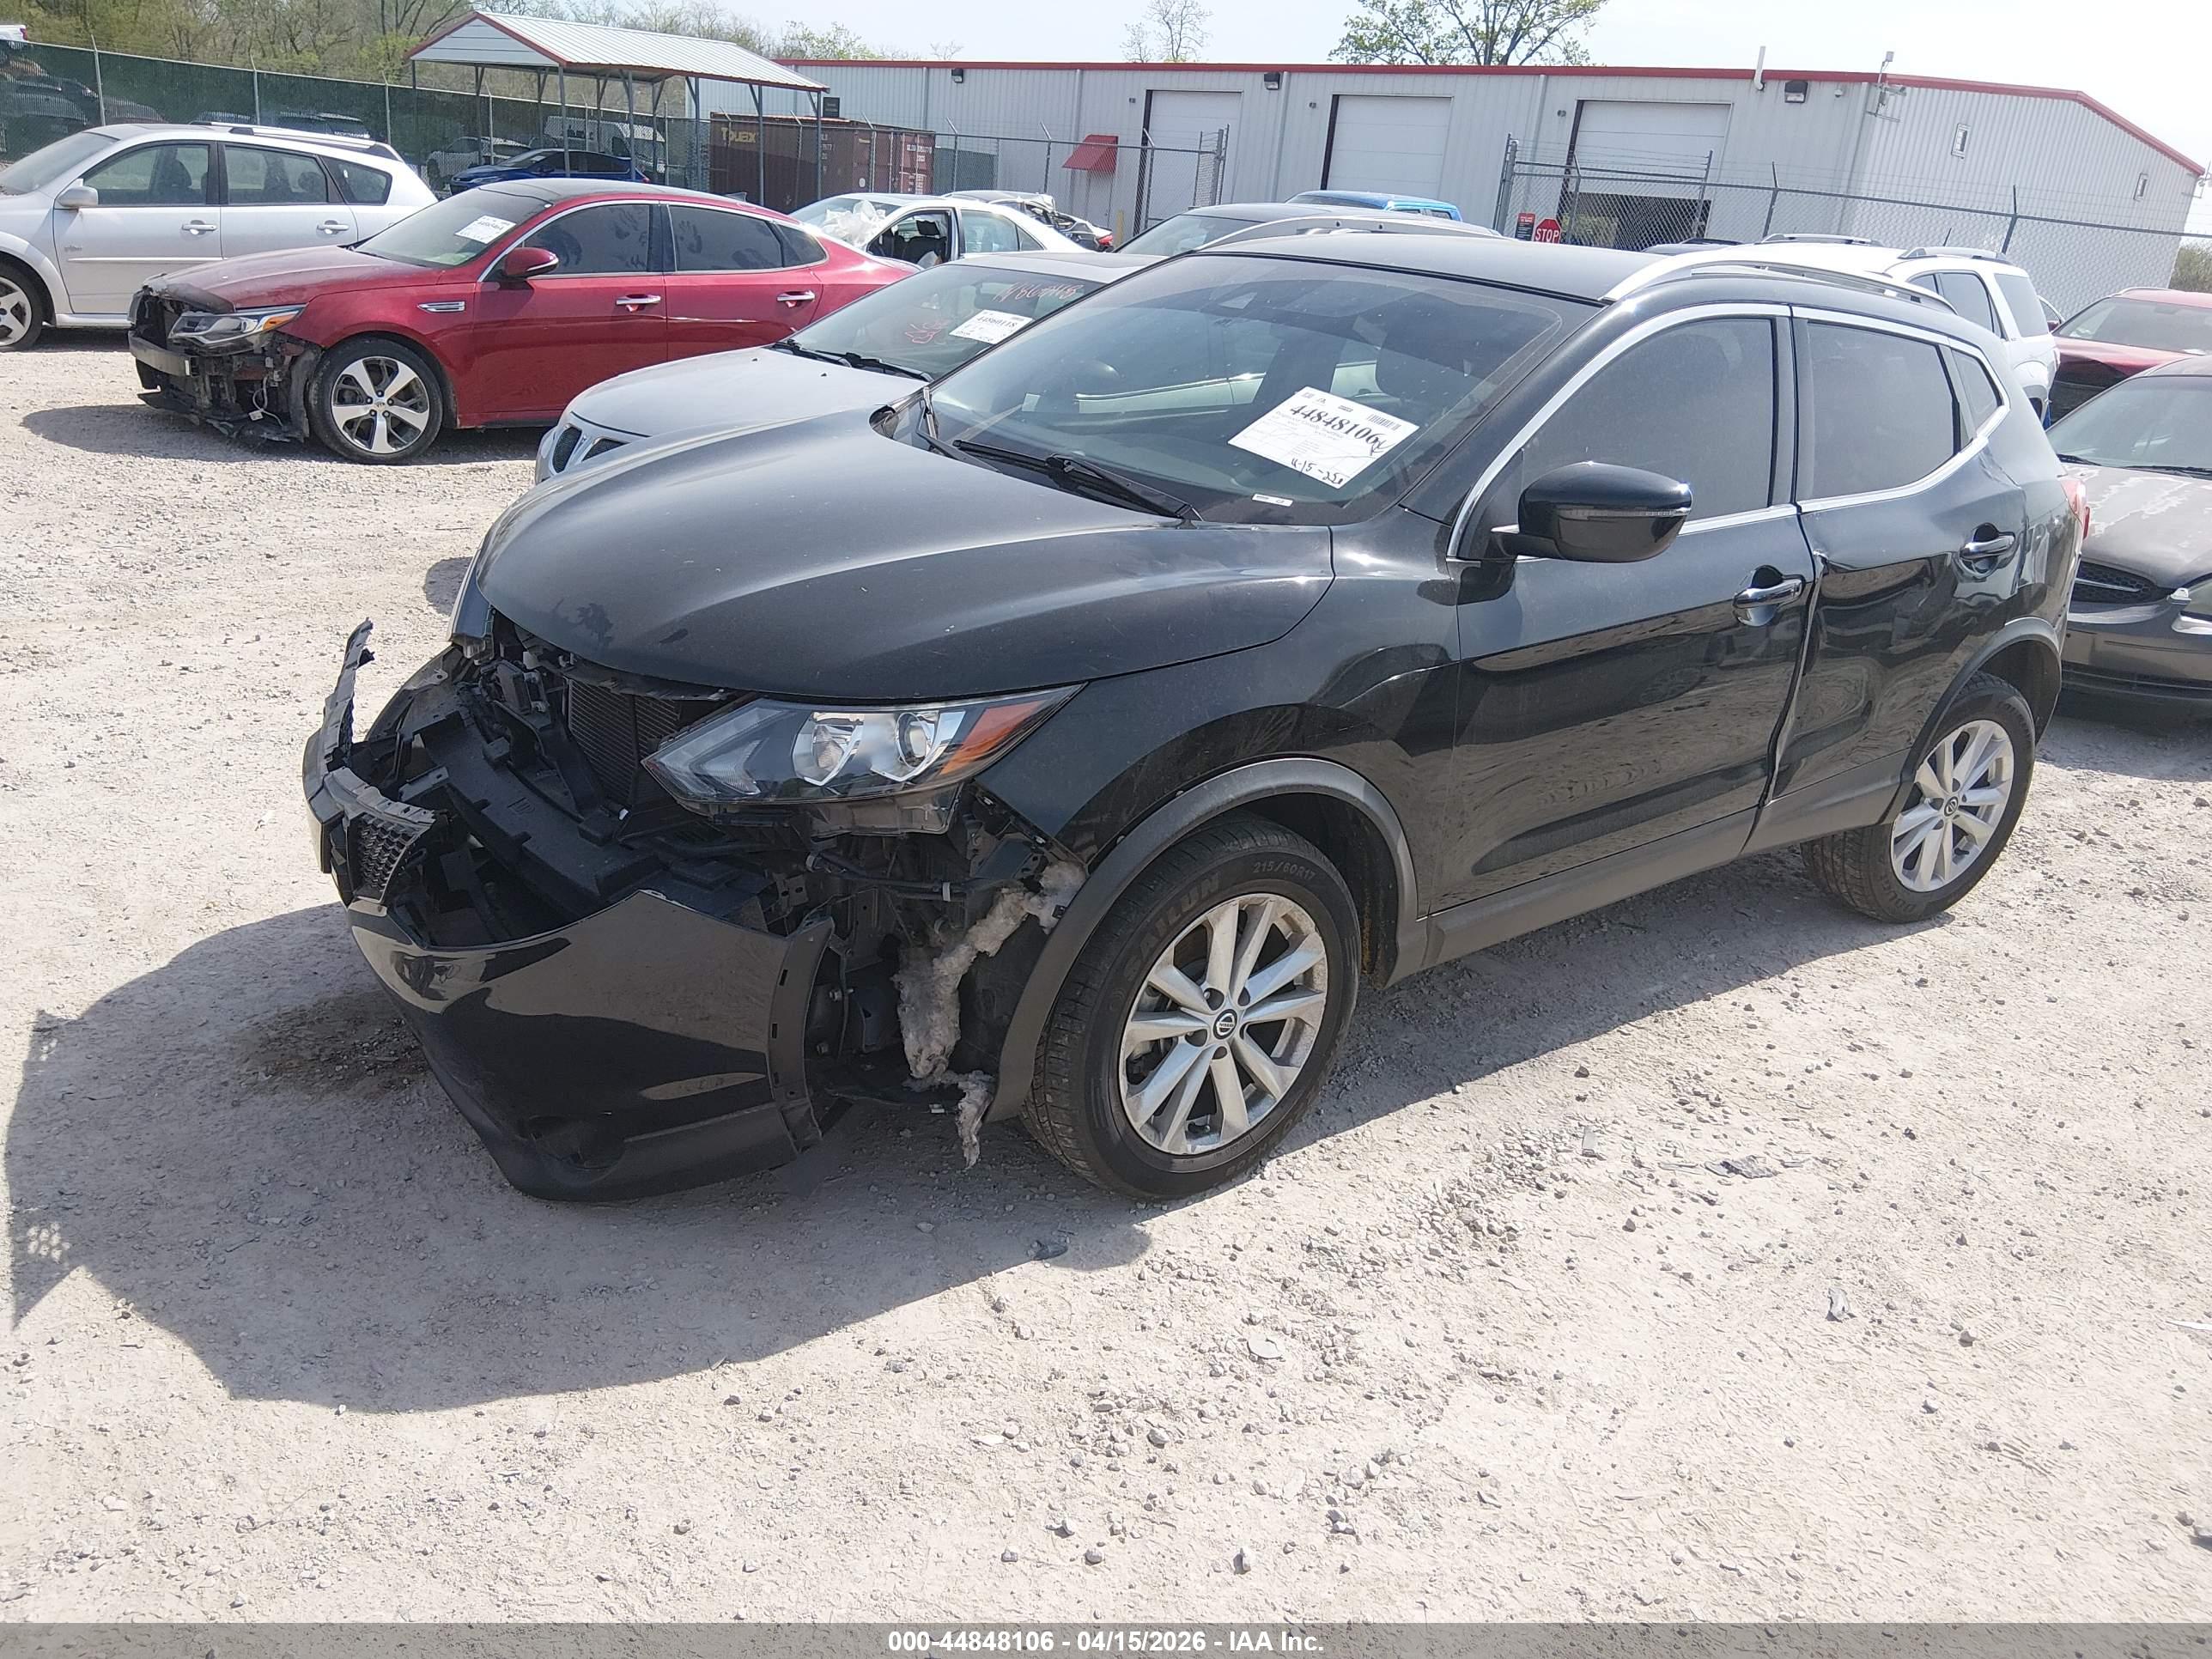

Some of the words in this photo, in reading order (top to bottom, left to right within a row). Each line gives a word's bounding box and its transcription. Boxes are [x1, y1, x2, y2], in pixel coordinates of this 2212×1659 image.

[1534, 228, 1559, 244] STOP
[1290, 404, 1382, 446] 44848106
[1253, 860, 1316, 880] 215/60R17
